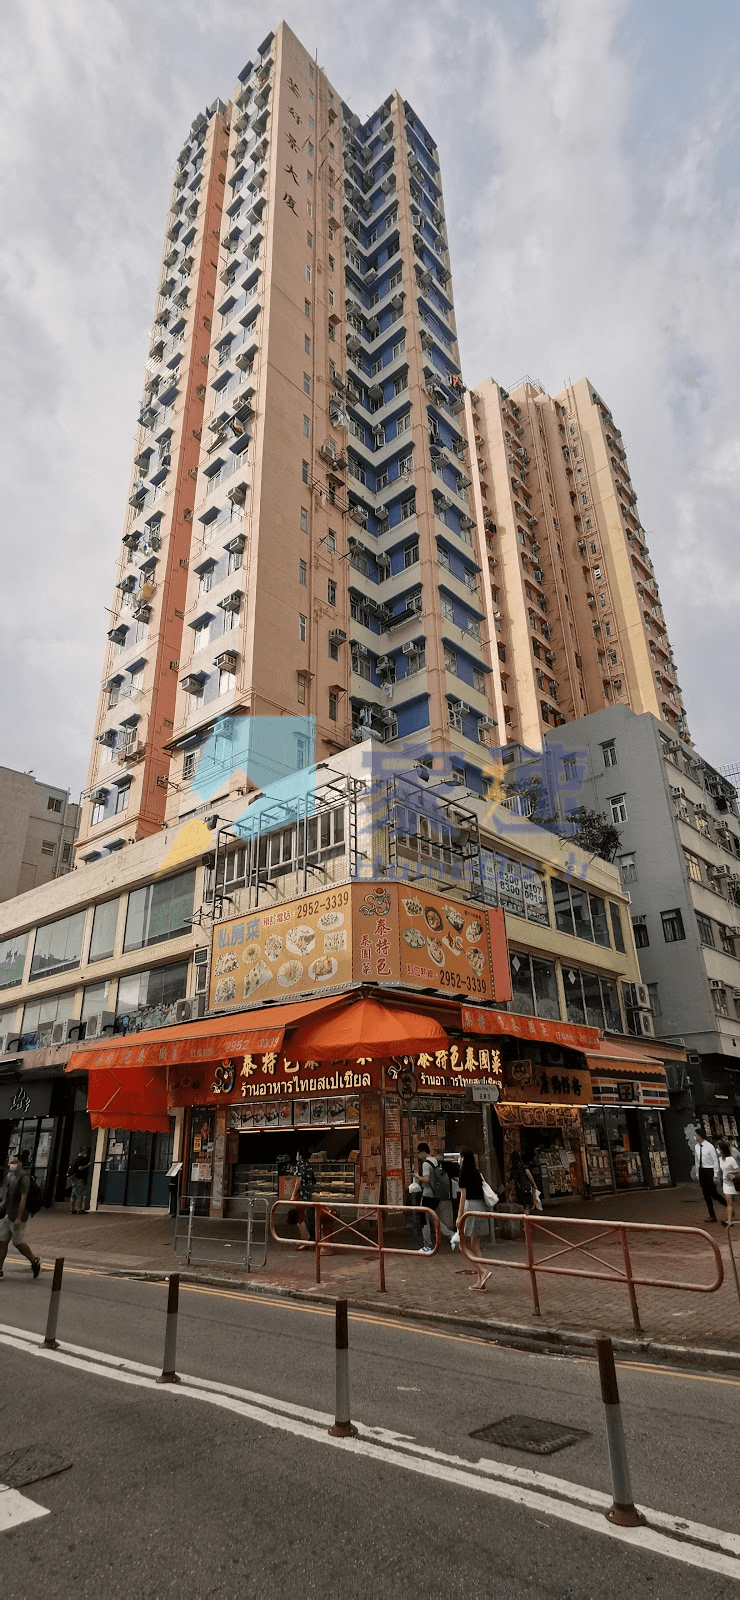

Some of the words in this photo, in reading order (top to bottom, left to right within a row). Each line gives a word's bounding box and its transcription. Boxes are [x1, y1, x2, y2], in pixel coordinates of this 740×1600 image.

[500, 881, 520, 896] 8300
[297, 891, 349, 919] 2952-3339
[217, 918, 260, 950] 私房菜
[374, 918, 392, 976] 泰特色
[440, 969, 487, 994] 2952-3339
[225, 1040, 249, 1053] 2952
[240, 1070, 372, 1098] ร้านอาหารไทยสเปเชียล
